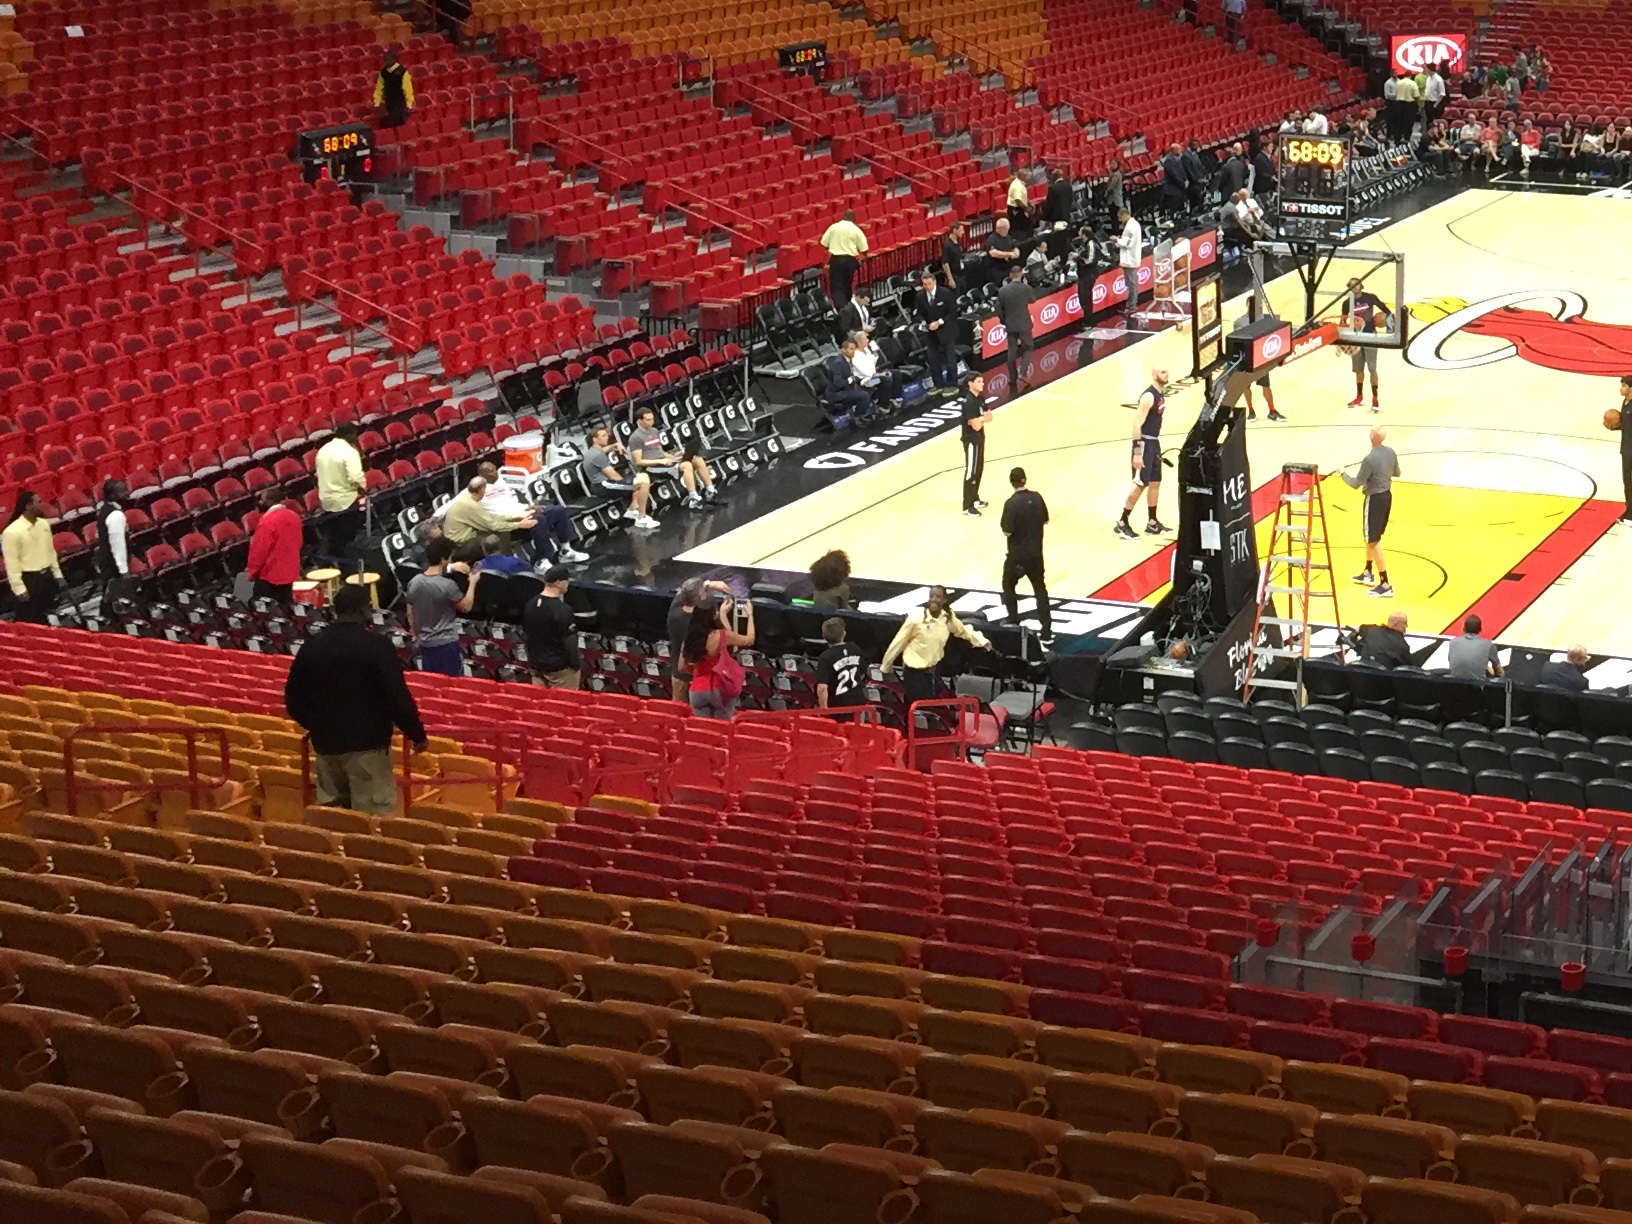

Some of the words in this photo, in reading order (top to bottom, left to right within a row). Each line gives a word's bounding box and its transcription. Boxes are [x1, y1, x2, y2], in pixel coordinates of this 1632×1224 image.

[1407, 44, 1450, 65] KIA
[324, 132, 358, 153] 68:09
[1289, 141, 1342, 164] 68:09
[1299, 203, 1344, 215] TISSOT
[693, 395, 702, 408] G
[746, 398, 756, 411] G
[669, 403, 679, 416] G
[726, 405, 735, 419] G
[705, 415, 714, 428] G
[621, 422, 631, 436] G
[681, 423, 691, 437] G
[659, 432, 669, 446] G
[767, 439, 779, 453] G
[608, 451, 619, 465] G
[747, 448, 759, 461] G
[726, 456, 739, 470] G
[560, 469, 571, 485] G
[534, 479, 546, 495] G
[658, 485, 671, 499] G
[407, 507, 420, 523] G
[608, 506, 620, 520] G
[583, 515, 597, 531] G
[392, 533, 405, 549] G
[1229, 529, 1249, 564] STK
[836, 667, 857, 695] 21
